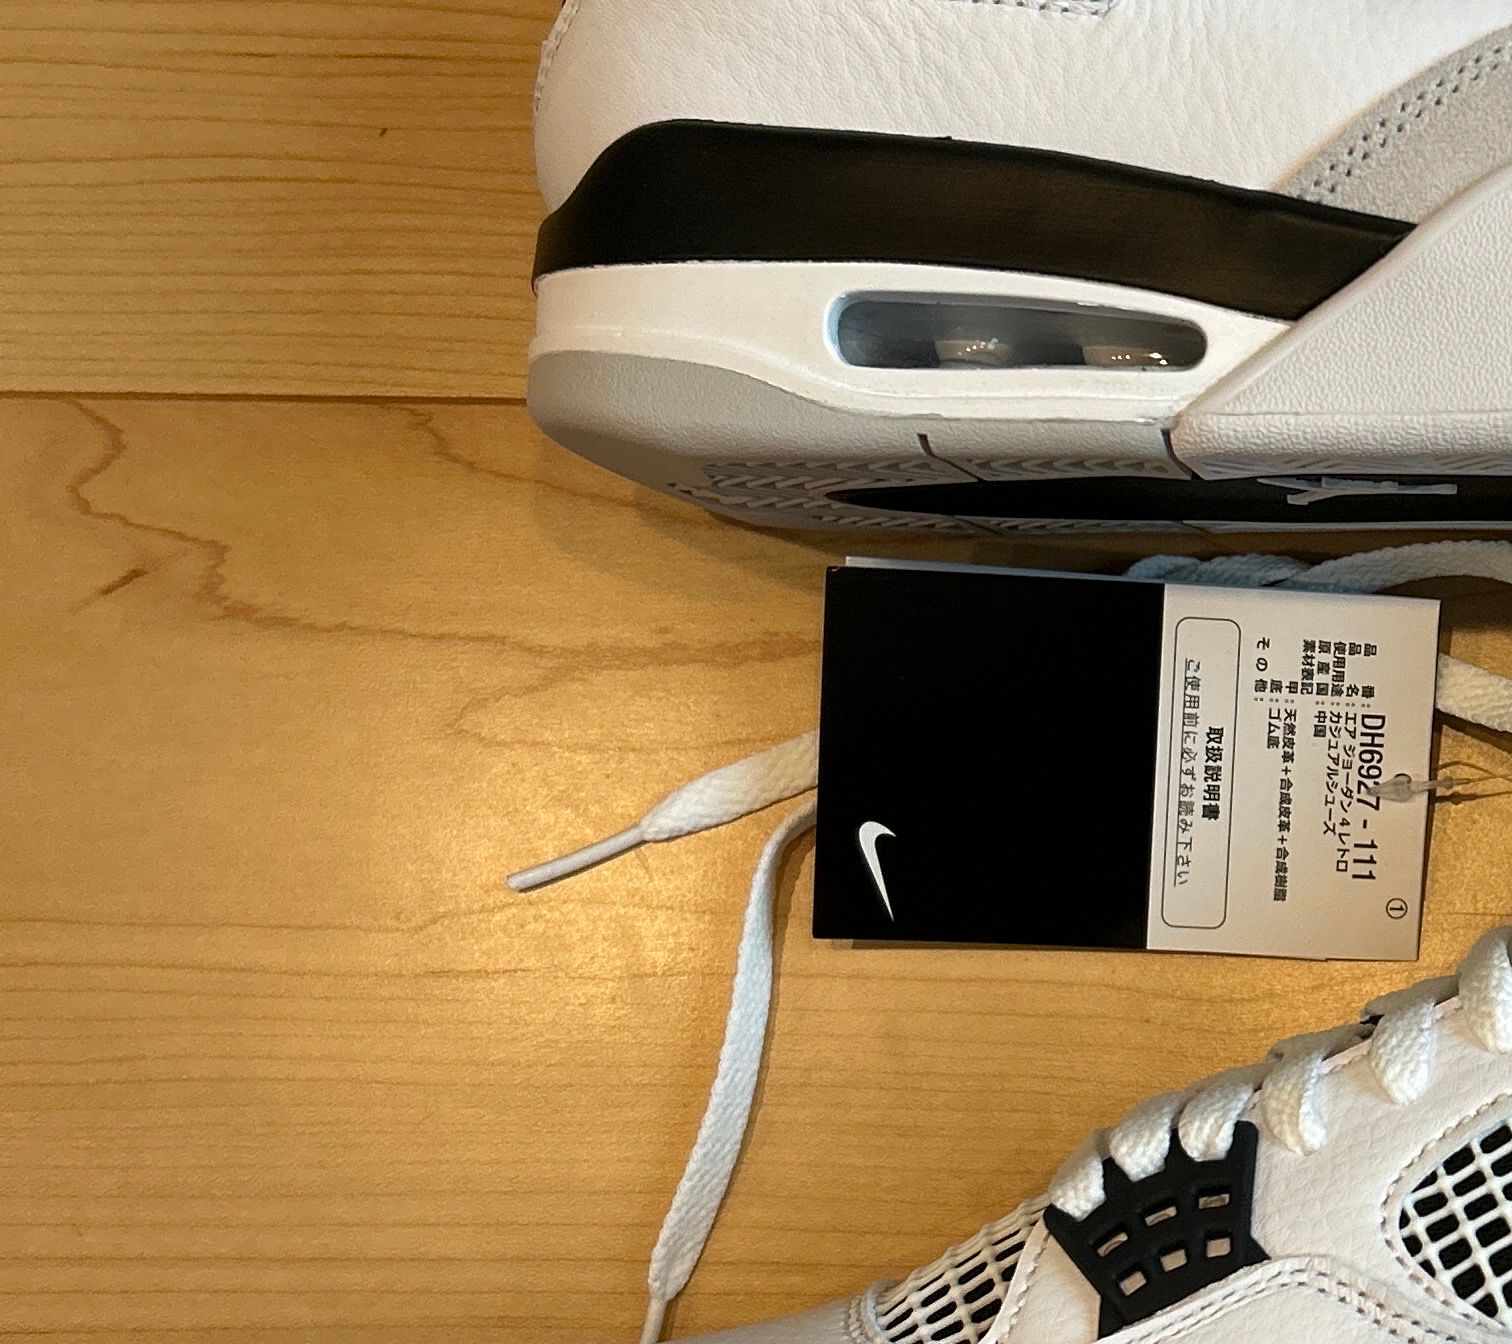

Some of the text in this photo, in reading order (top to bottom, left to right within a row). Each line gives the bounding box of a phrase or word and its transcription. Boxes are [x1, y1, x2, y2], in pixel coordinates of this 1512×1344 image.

[1300, 639, 1316, 695] 素材表記
[1175, 657, 1201, 885] ご使用前に必ずお読み下さい
[1313, 710, 1328, 738] 中国
[1201, 726, 1224, 821] 取扱説明書
[1323, 710, 1342, 835] カジュアルシューズ
